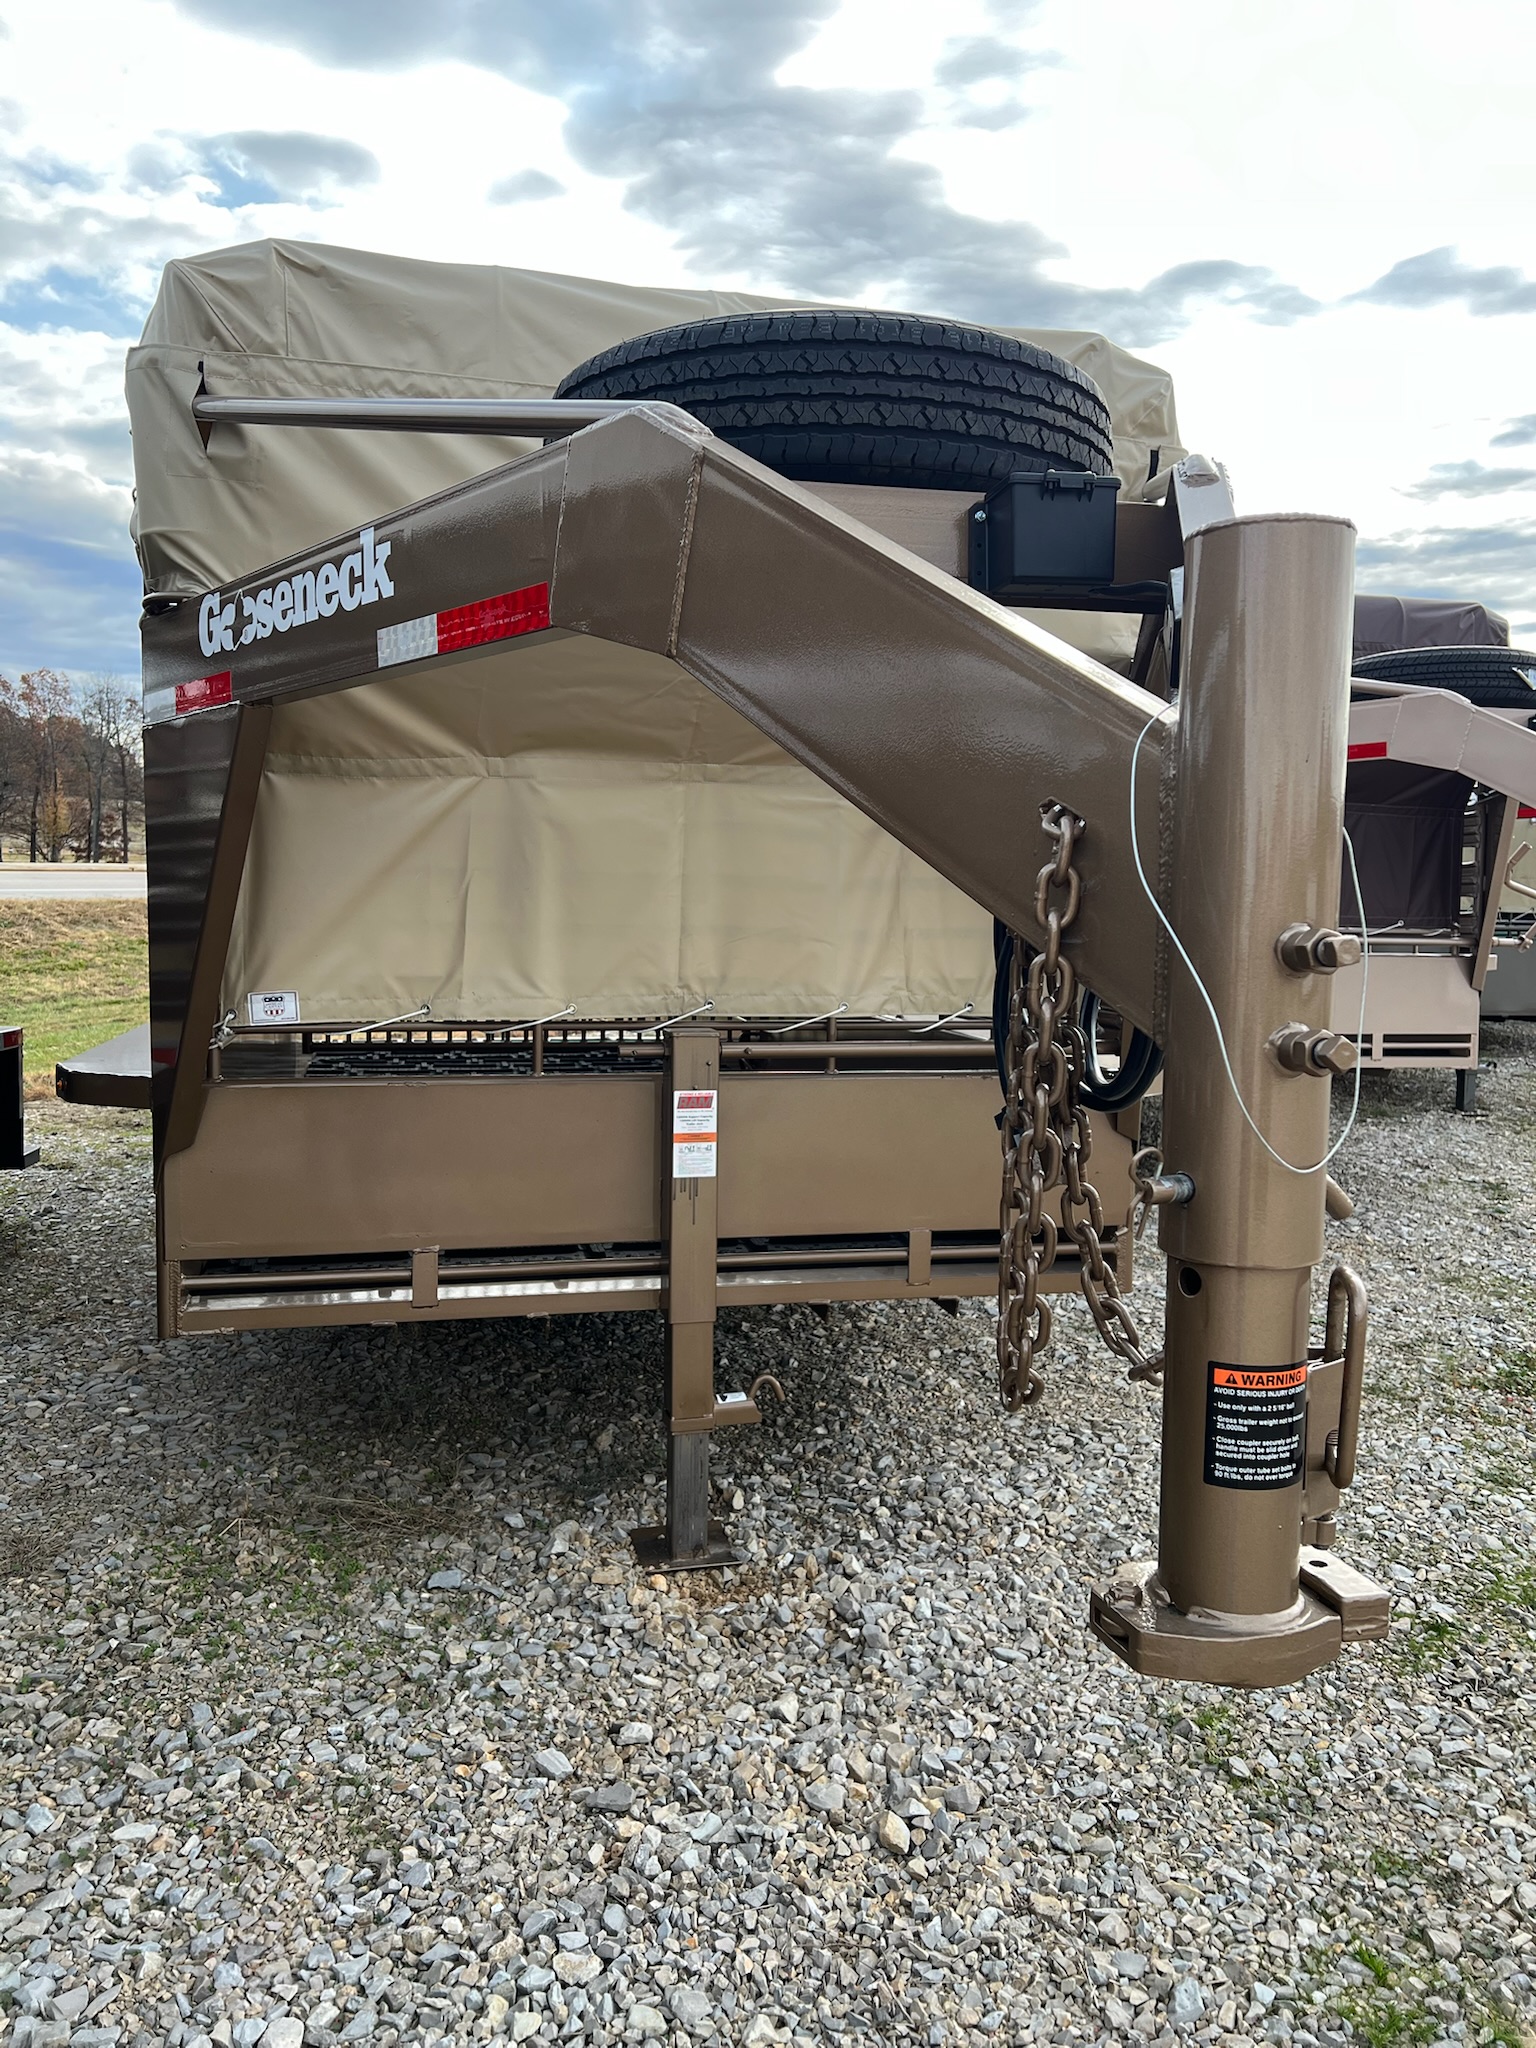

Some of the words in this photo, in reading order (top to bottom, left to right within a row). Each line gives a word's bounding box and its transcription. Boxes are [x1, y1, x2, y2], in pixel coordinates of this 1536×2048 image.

[199, 527, 394, 657] Gooseneck
[679, 1097, 712, 1108] RAM
[1241, 1371, 1301, 1386] WARNING
[1213, 1386, 1235, 1395] AVOID
[1236, 1389, 1266, 1398] SERIOUS
[1217, 1401, 1231, 1410] Use
[1231, 1404, 1247, 1412] only
[1217, 1415, 1237, 1424] Gross
[1238, 1417, 1258, 1425] trailer
[1258, 1418, 1278, 1427] weight
[1216, 1435, 1236, 1444] Close
[1236, 1439, 1261, 1447] coupler
[1262, 1438, 1285, 1446] securely
[1215, 1442, 1238, 1452] handle
[1277, 1444, 1290, 1452] down
[1215, 1450, 1242, 1459] secured
[1256, 1453, 1279, 1461] coupler
[1279, 1451, 1290, 1459] hole
[1214, 1463, 1238, 1473] Torque
[1280, 1464, 1292, 1472] bolts
[1278, 1471, 1294, 1479] torque
